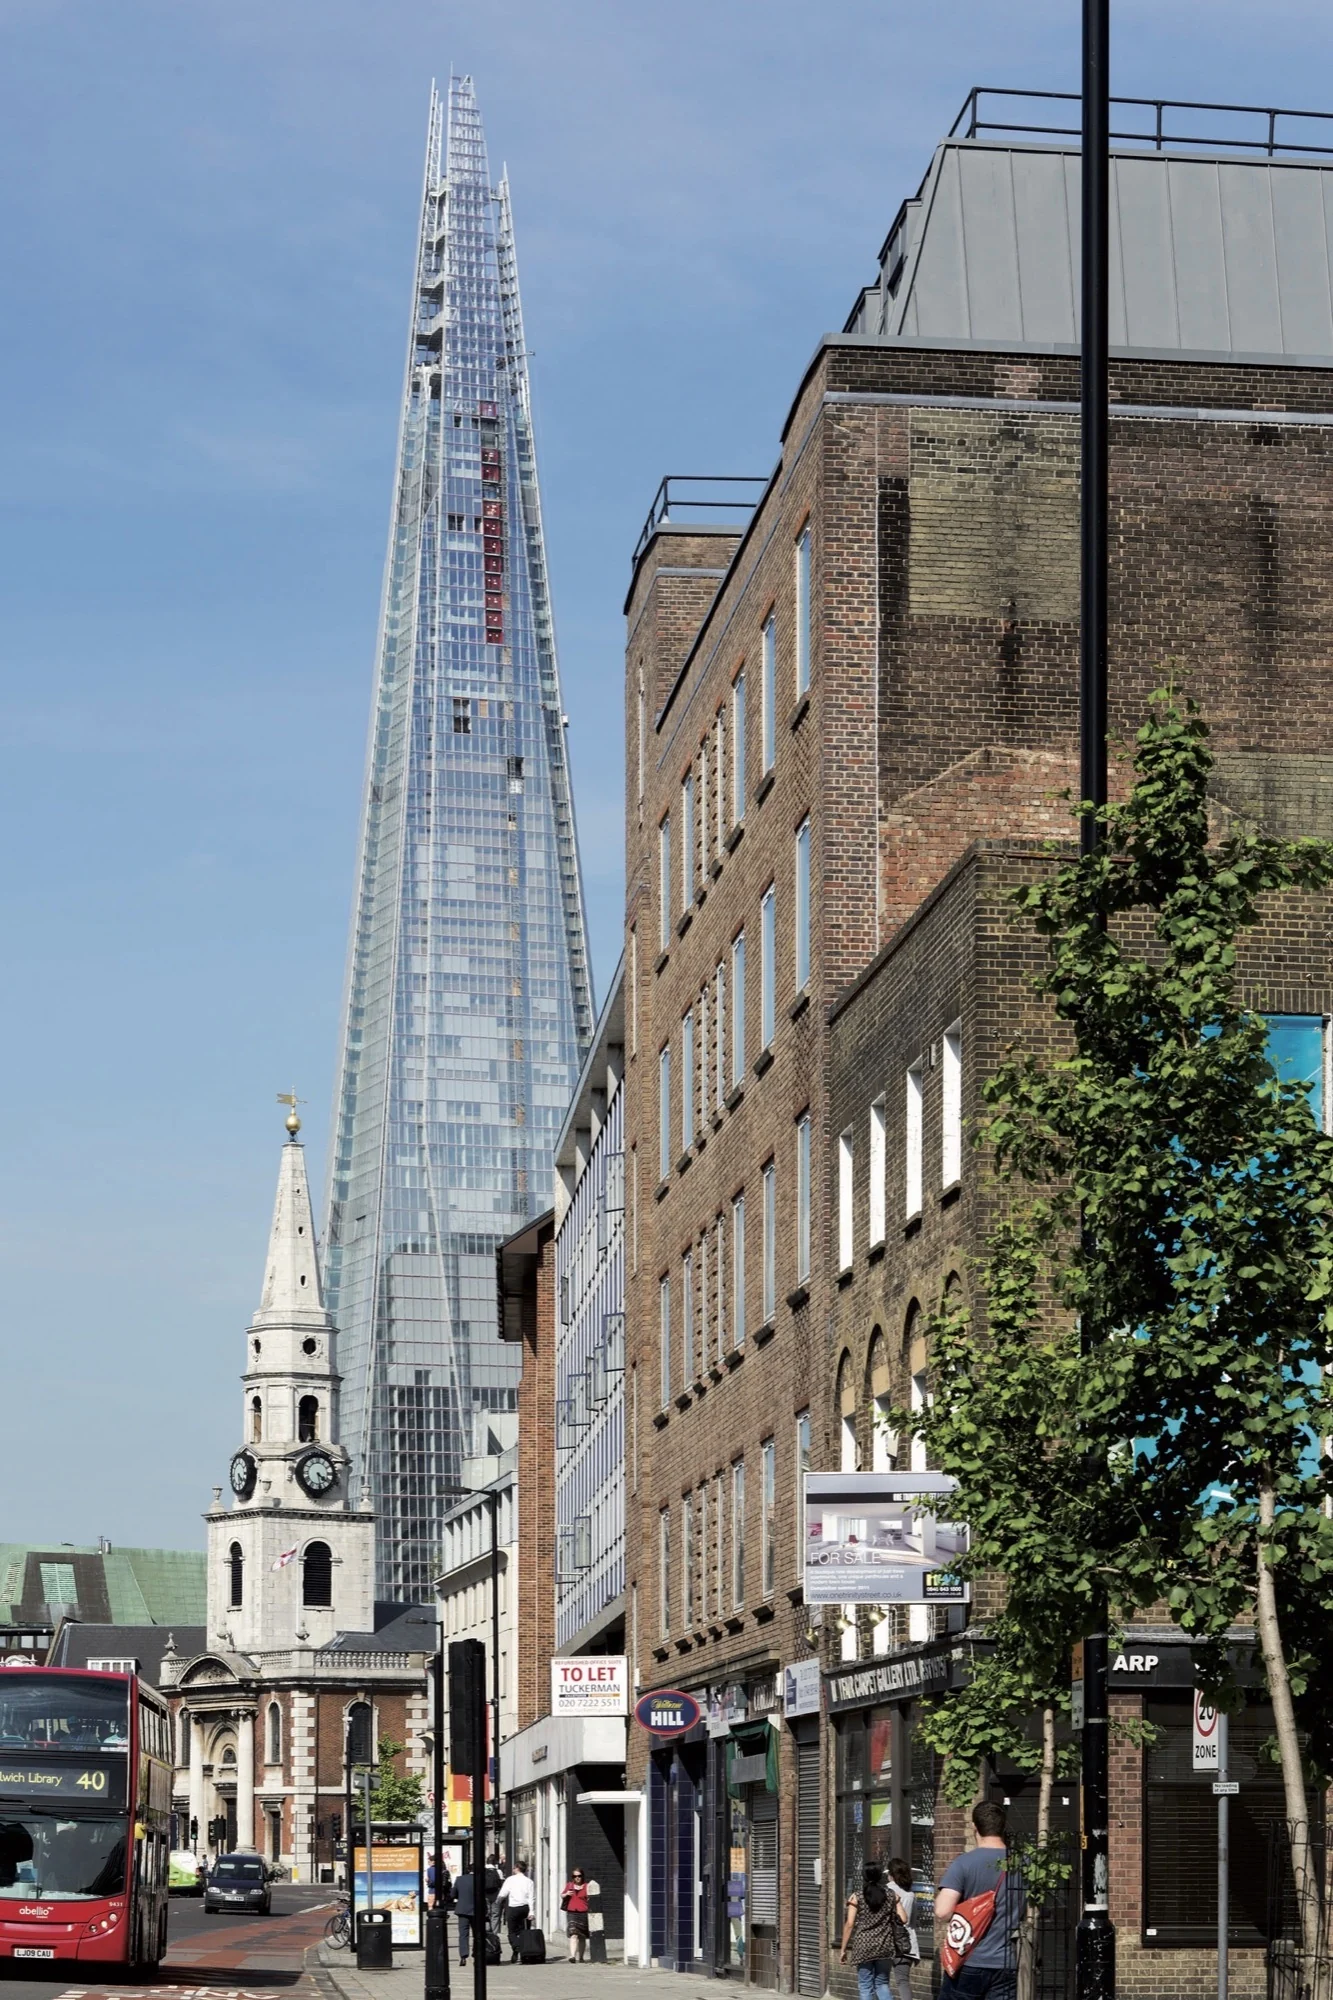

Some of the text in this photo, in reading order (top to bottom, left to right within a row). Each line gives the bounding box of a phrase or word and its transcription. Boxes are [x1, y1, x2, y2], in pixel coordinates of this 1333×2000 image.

[810, 1552, 881, 1564] FOR SALE
[1112, 1654, 1159, 1671] ARP
[561, 1667, 616, 1682] TO LET
[558, 1684, 620, 1693] TUCKERMAN
[558, 1699, 621, 1708] 020 7222 5511
[651, 1711, 684, 1726] HILL
[1195, 1744, 1217, 1758] ZONE
[28, 1772, 62, 1787] Library
[76, 1770, 105, 1791] 40
[19, 1906, 49, 1915] abellio
[16, 1949, 51, 1958] LJ09 CAU
